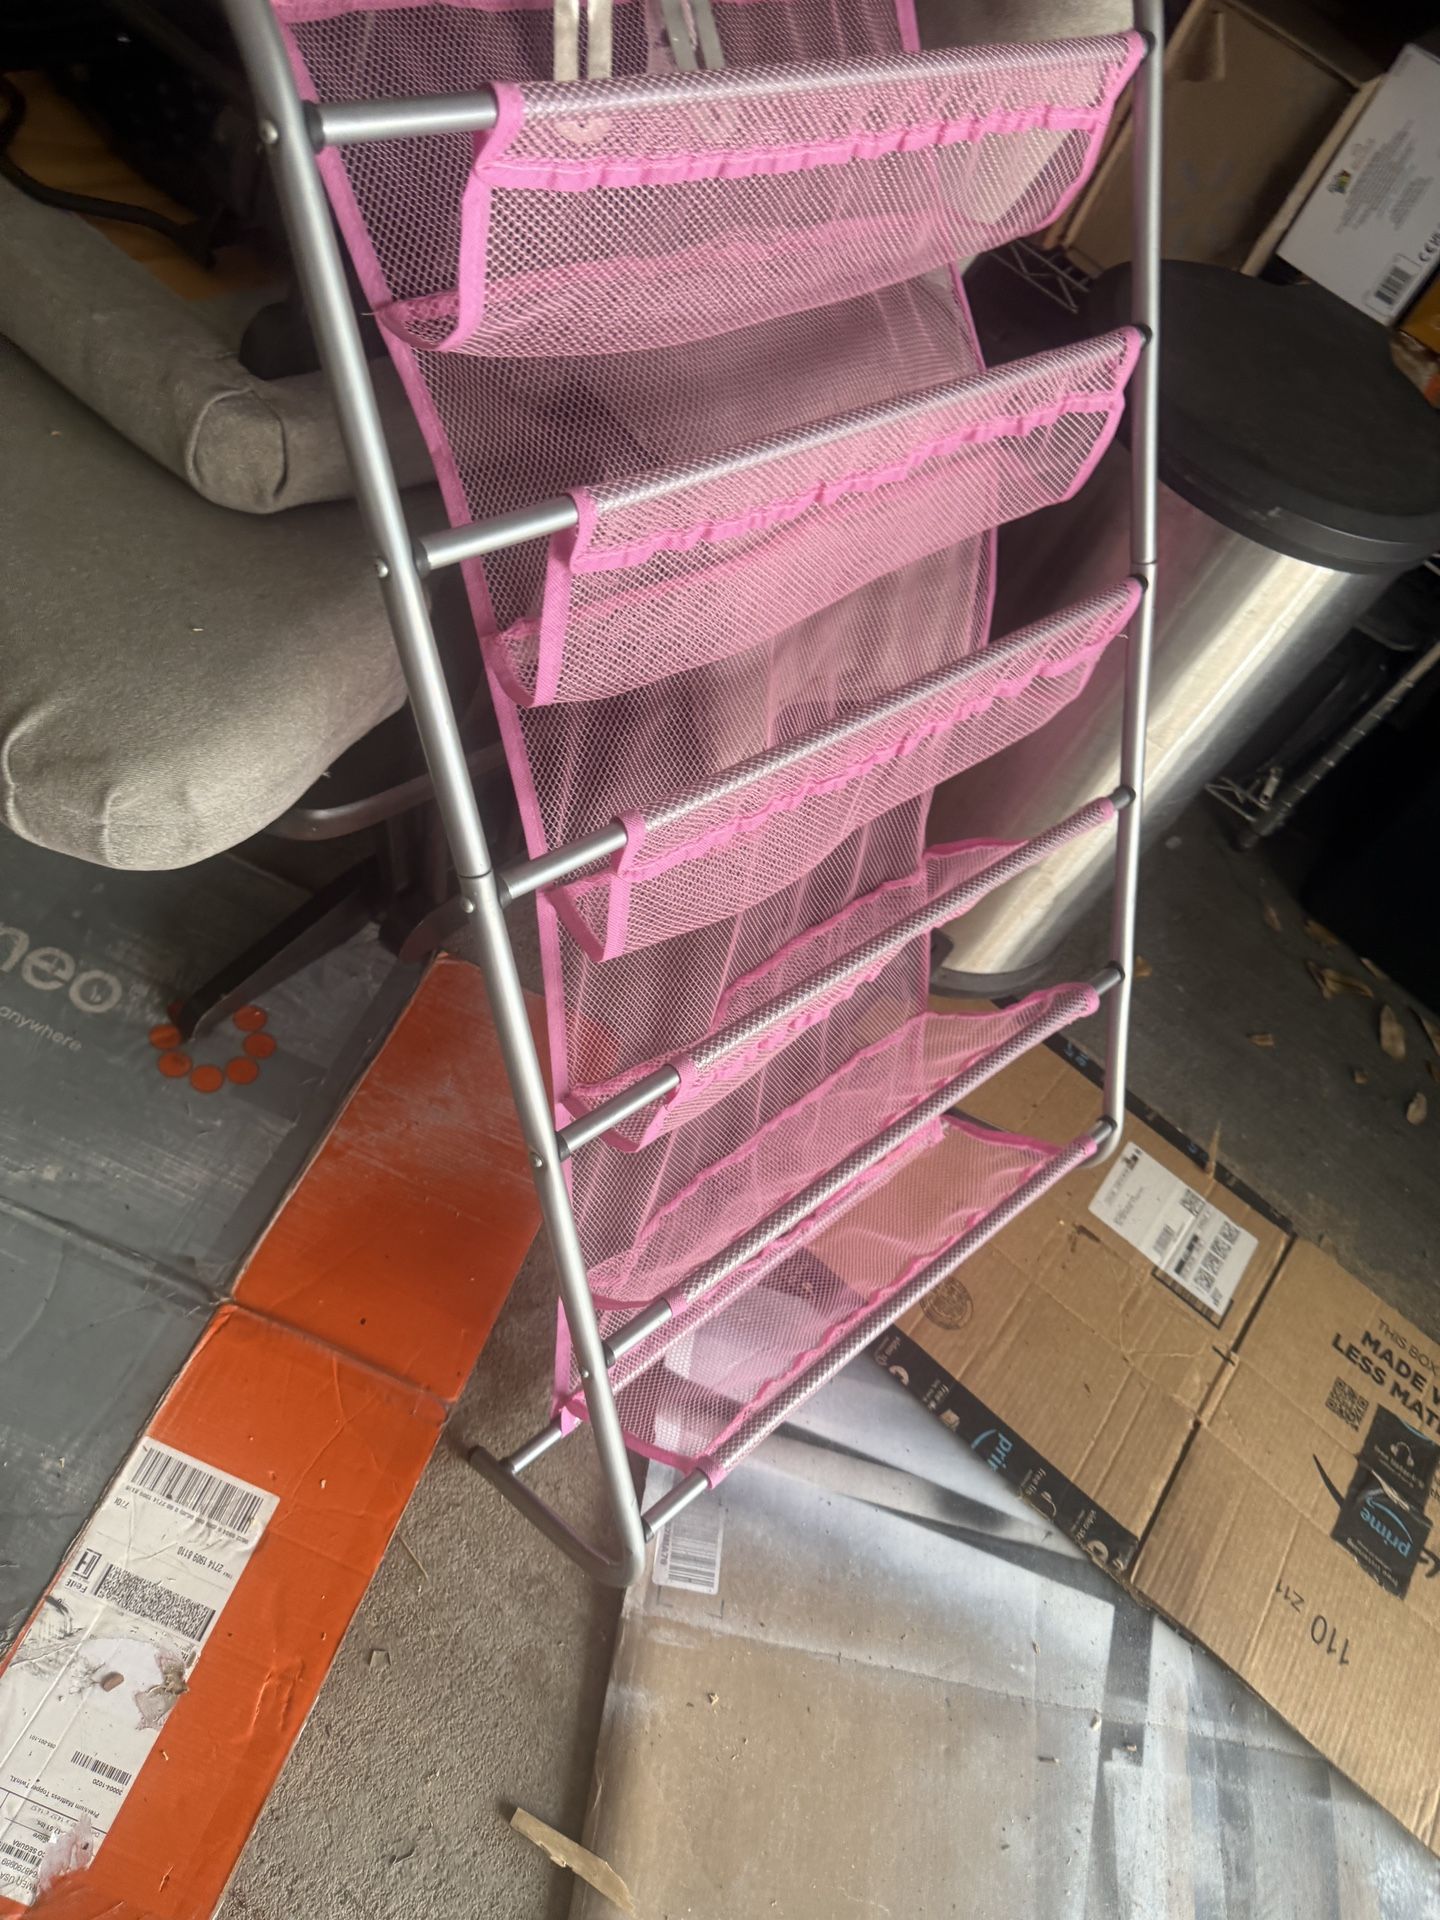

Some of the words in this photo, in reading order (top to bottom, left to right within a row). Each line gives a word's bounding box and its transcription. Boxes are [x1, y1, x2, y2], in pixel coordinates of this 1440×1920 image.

[0, 1006, 81, 1051] anywhere
[1332, 1332, 1386, 1386] LESS
[1361, 1331, 1427, 1393] MADE
[1378, 1319, 1407, 1350] THIS
[1408, 1345, 1439, 1376] BOX
[1360, 1506, 1411, 1558] prime
[176, 1545, 193, 1559] 8110
[192, 1552, 207, 1565] 1909
[207, 1558, 224, 1572] 2714
[1275, 1576, 1306, 1611] Z11
[1311, 1614, 1349, 1664] 110
[50, 1793, 74, 1807] Mattress
[12, 1839, 37, 1854] SEGURA
[0, 1871, 15, 1882] USA
